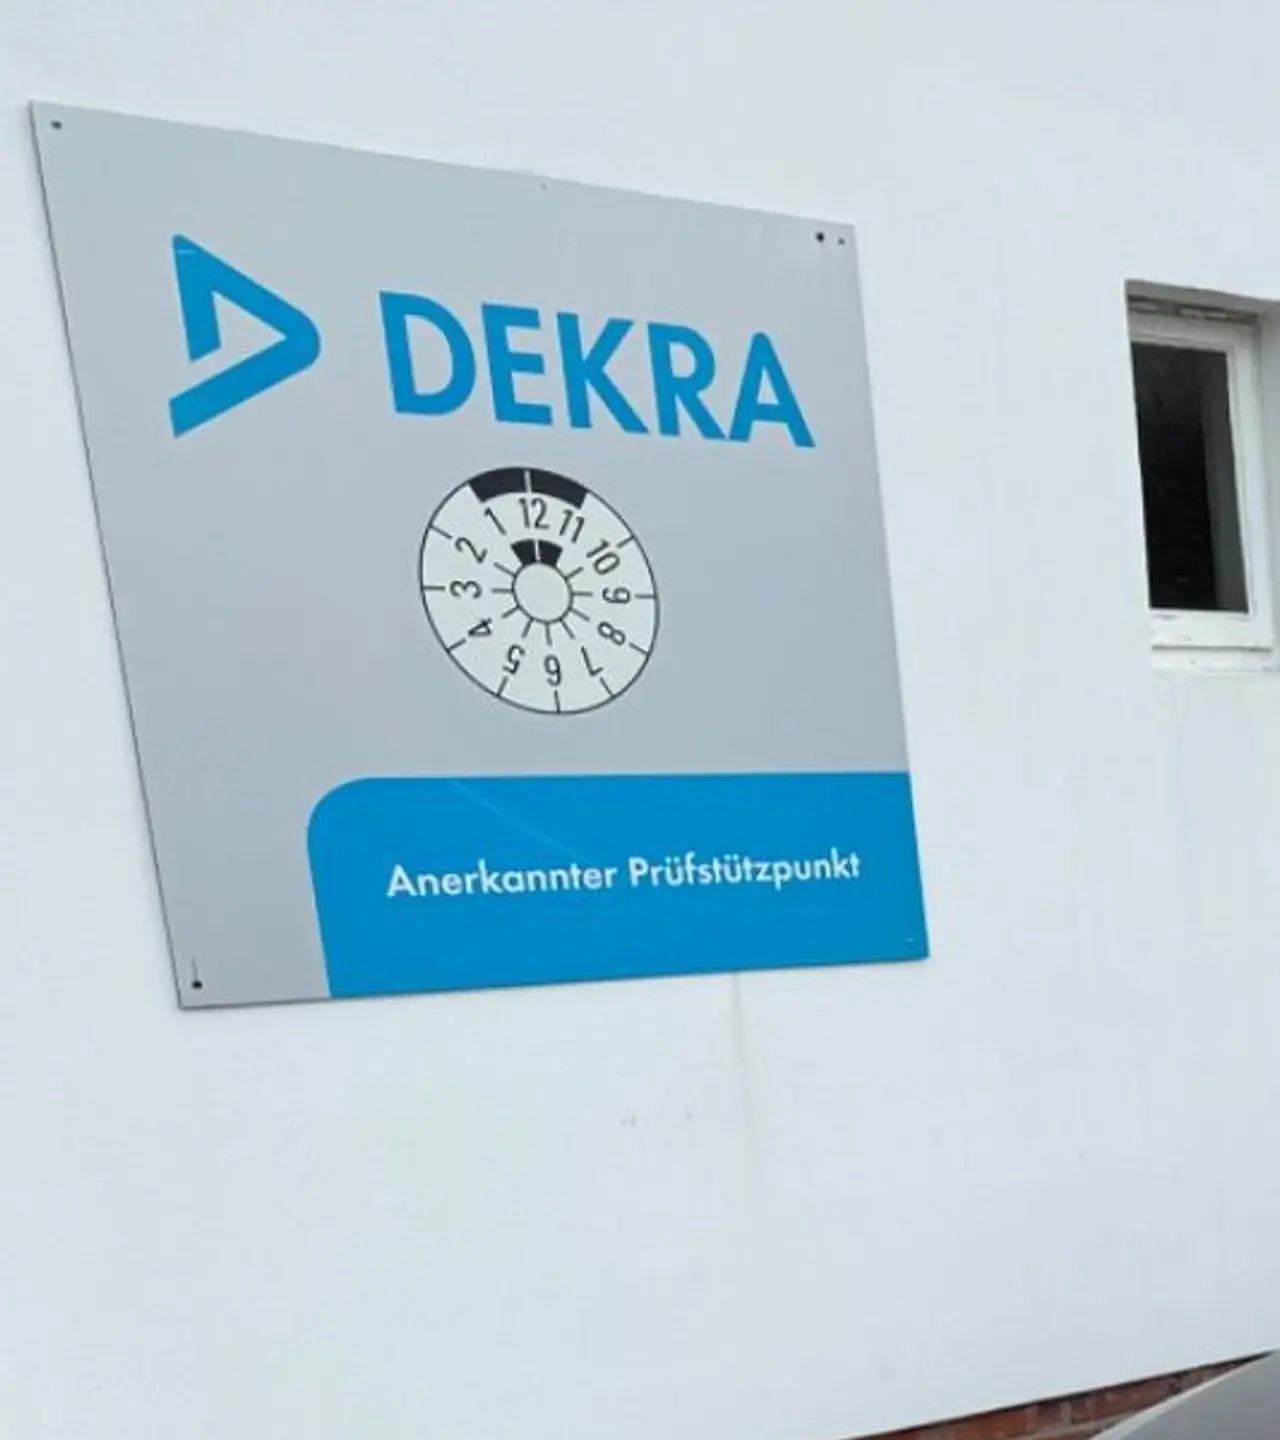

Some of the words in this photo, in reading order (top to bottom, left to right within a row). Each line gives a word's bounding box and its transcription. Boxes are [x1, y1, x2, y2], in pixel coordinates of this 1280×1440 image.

[379, 290, 816, 447] DEKRA
[484, 506, 507, 535] 1
[518, 497, 550, 530] 12
[559, 508, 585, 543] 11
[454, 536, 488, 564] 2
[586, 538, 621, 576] 10
[449, 580, 482, 599] 3
[468, 617, 492, 638] 4
[597, 621, 626, 646] 8
[502, 644, 526, 675] 5
[580, 645, 604, 677] 7
[386, 858, 617, 898] Anerkannter
[628, 846, 861, 890] Prüfstützpunkt
